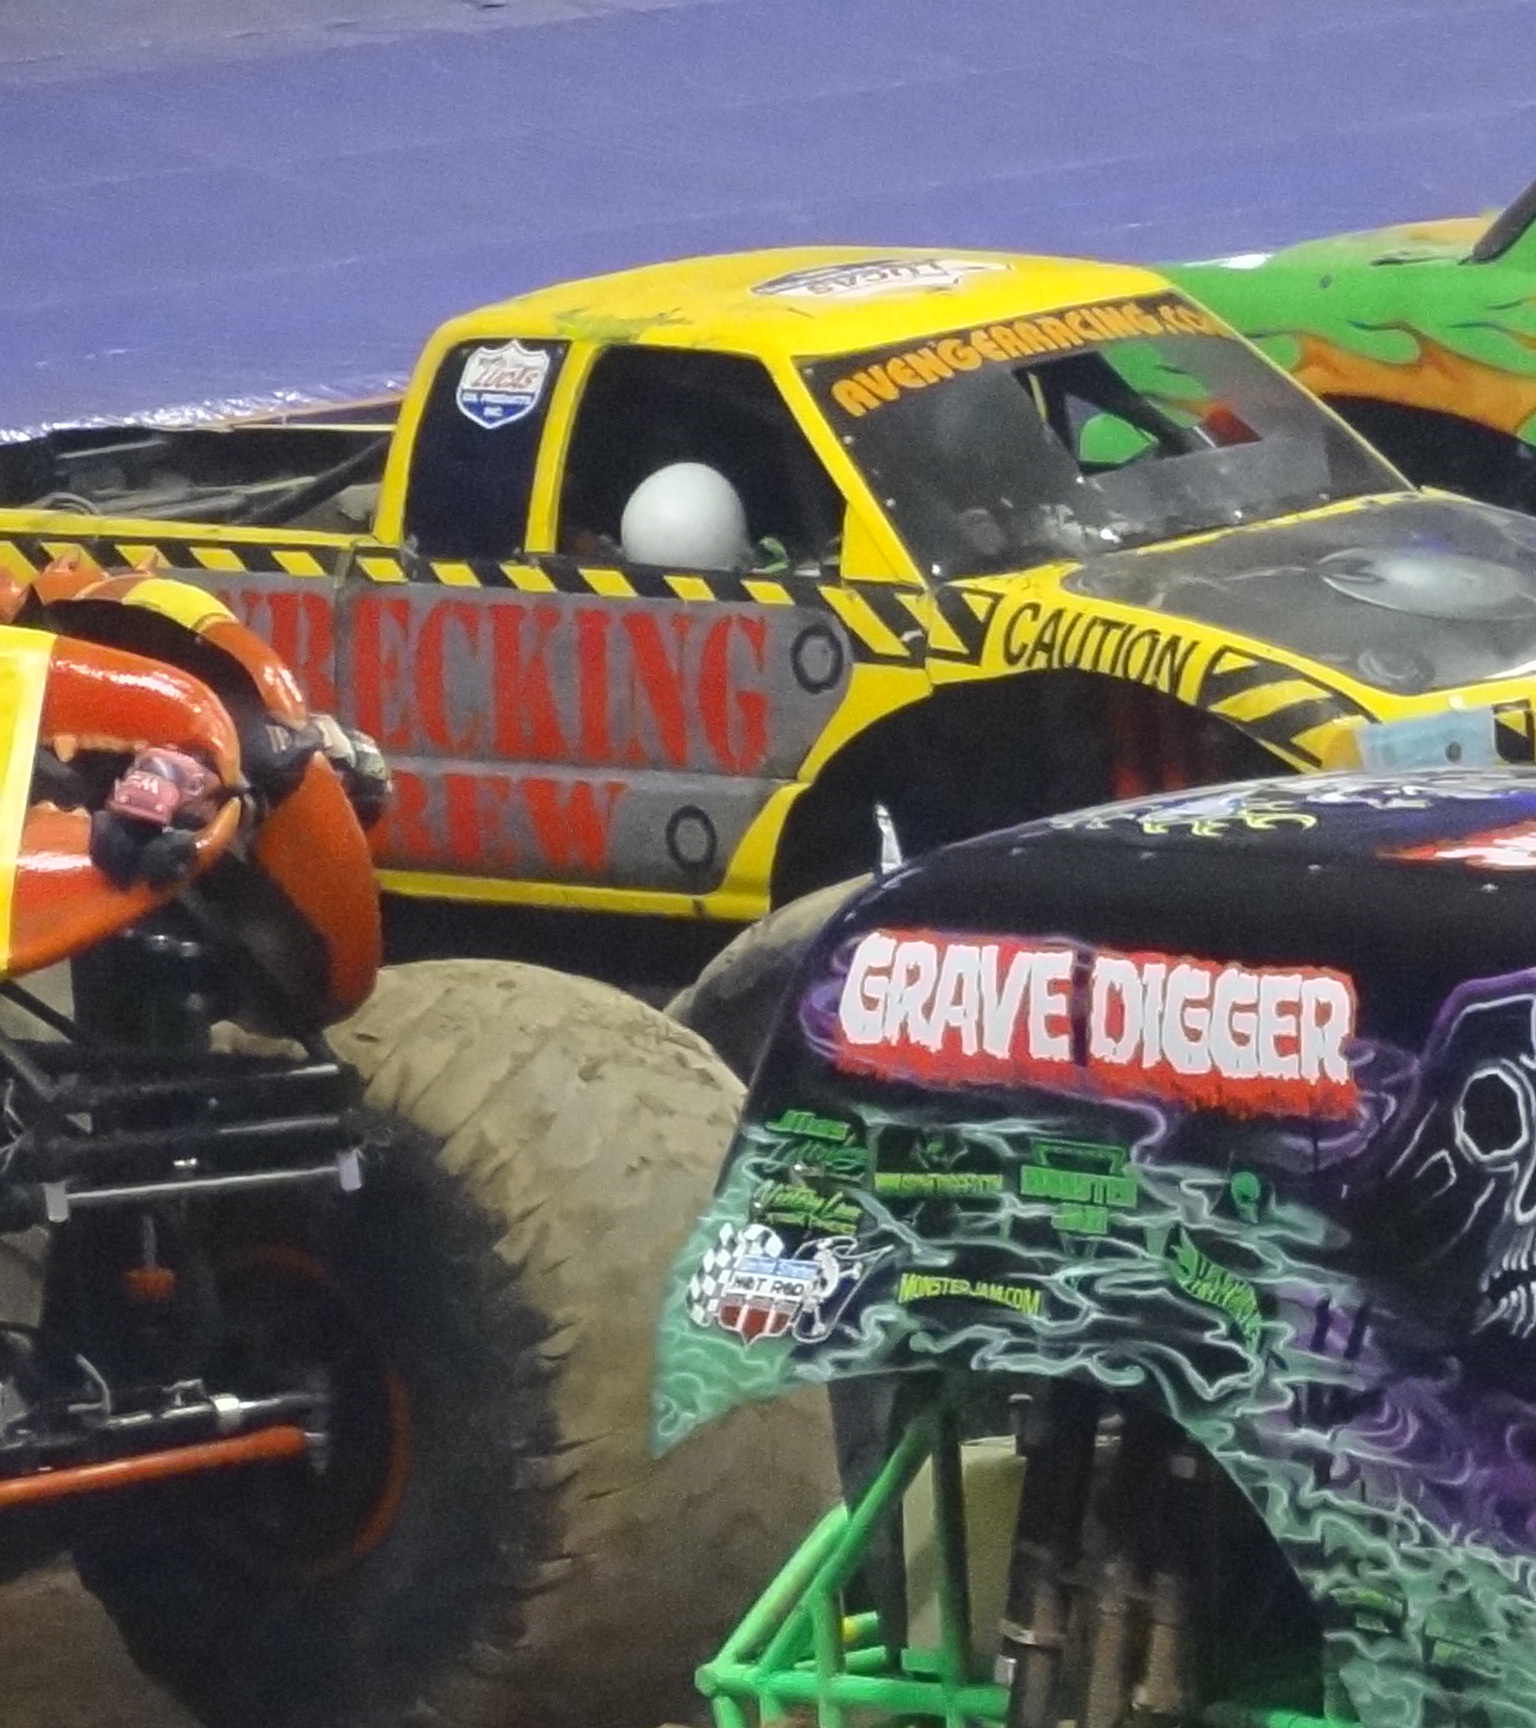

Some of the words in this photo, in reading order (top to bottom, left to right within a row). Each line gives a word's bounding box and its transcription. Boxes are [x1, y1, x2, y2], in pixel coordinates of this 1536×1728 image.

[220, 590, 768, 773] RECKING
[1003, 601, 1201, 696] CAUTION
[375, 768, 629, 872] REW
[838, 931, 1075, 1063] GRAVE
[1089, 955, 1352, 1087] DIGGER
[734, 1275, 768, 1291] HOT
[770, 1279, 804, 1297] ROD
